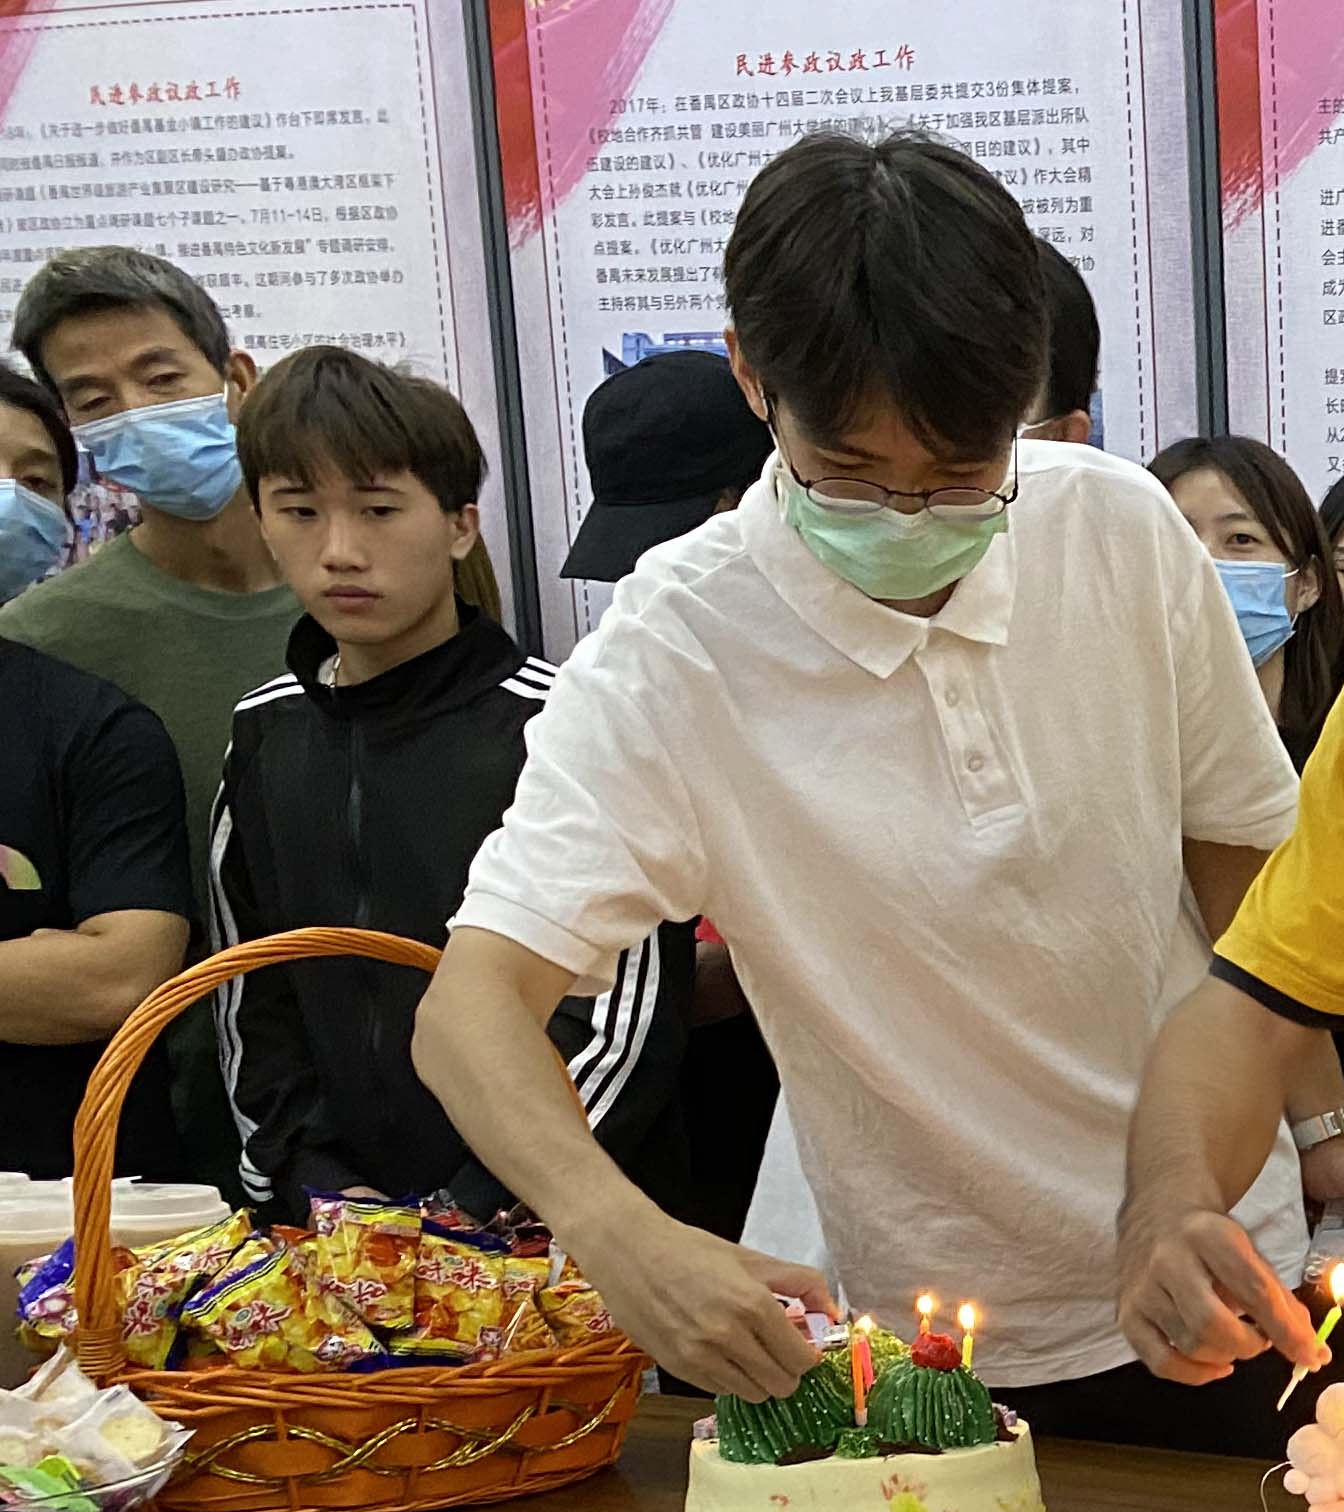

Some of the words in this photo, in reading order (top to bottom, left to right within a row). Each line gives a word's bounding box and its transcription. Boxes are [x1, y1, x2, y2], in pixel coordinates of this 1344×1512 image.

[735, 44, 916, 77] 民进参政议政工作
